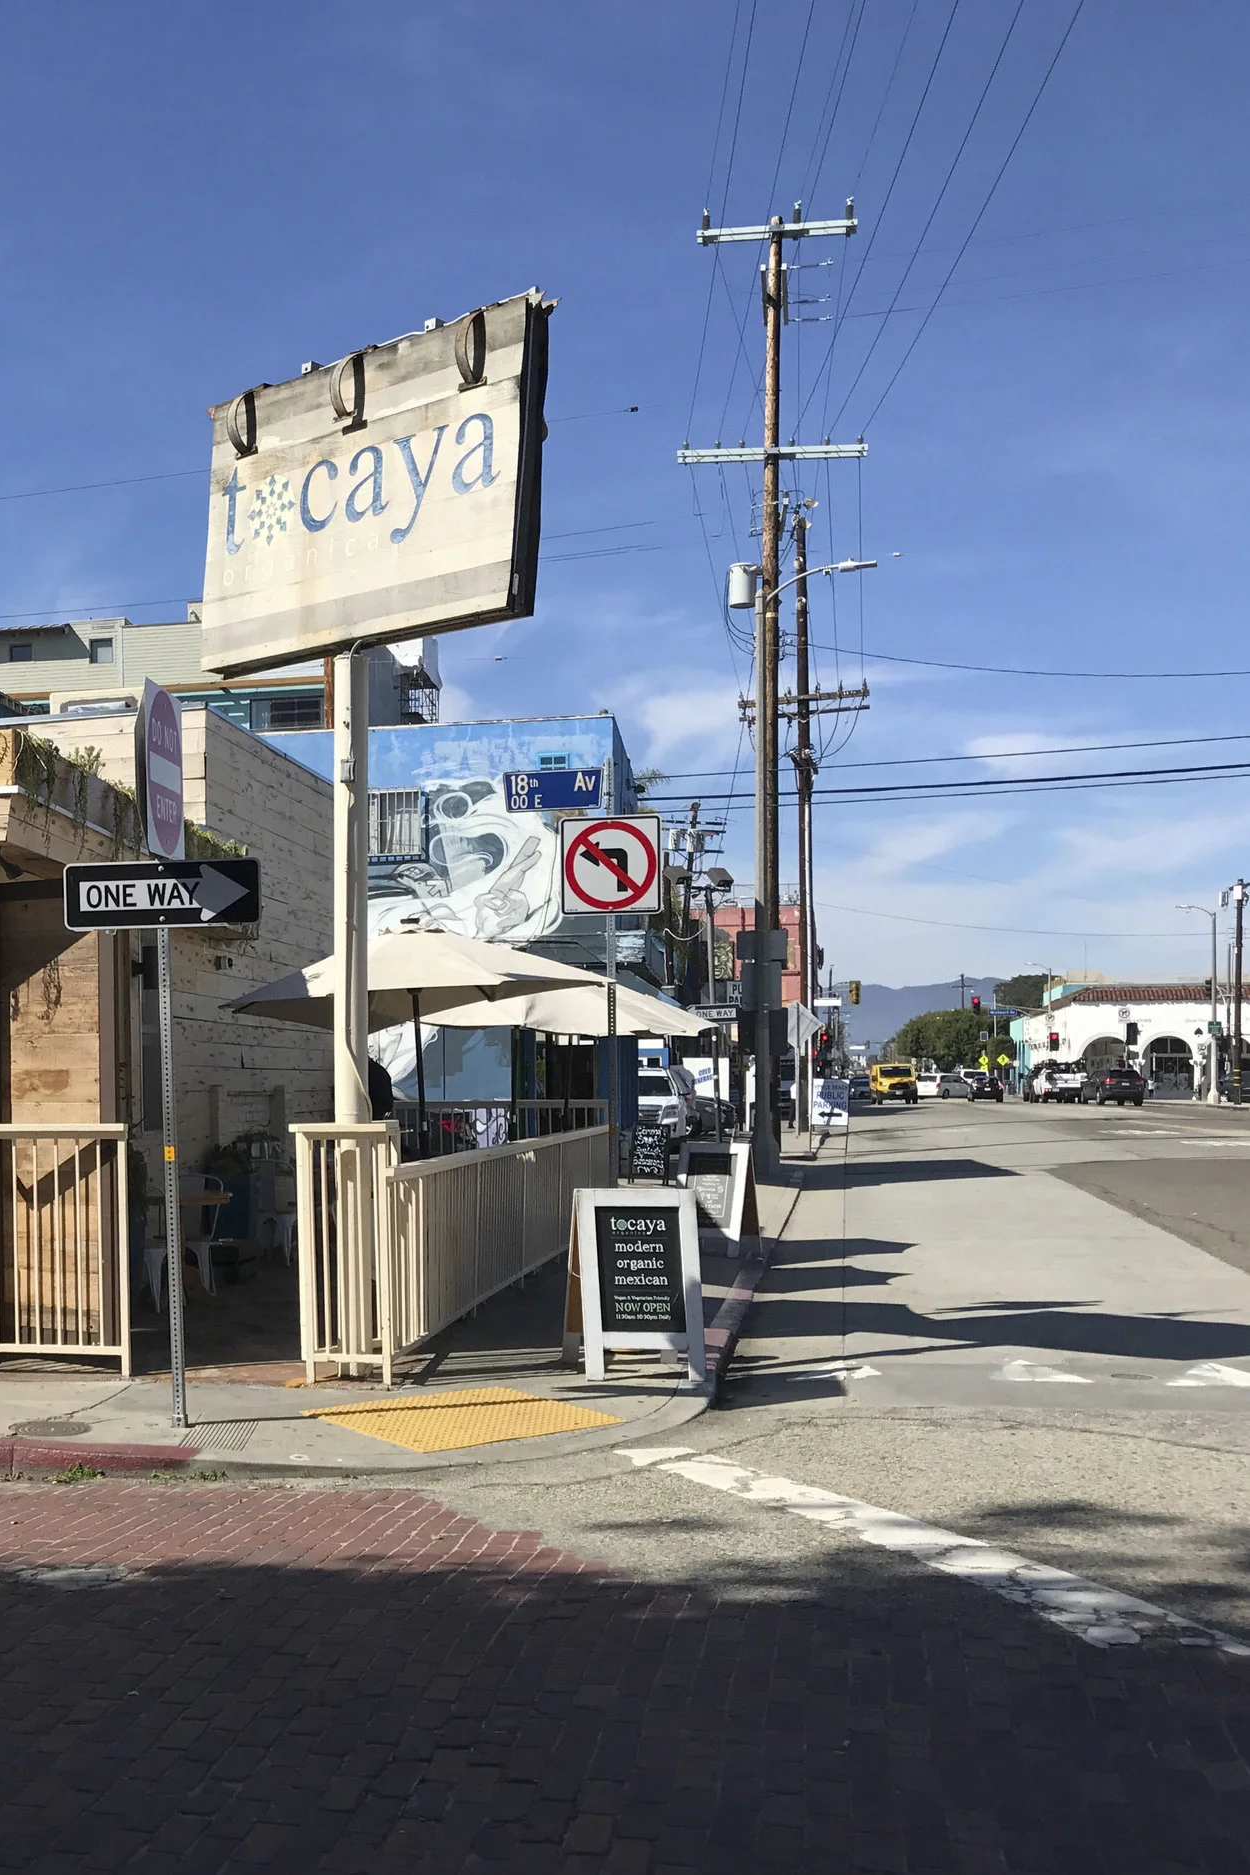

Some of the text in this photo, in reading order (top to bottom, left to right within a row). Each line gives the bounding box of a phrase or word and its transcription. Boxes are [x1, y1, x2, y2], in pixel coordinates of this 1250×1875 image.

[223, 532, 380, 587] organica
[151, 717, 178, 757] DO NOT
[510, 771, 596, 795] 18th Av
[511, 794, 543, 810] 00 E
[155, 794, 178, 827] ENTER
[86, 881, 201, 909] ONE WAY
[695, 1008, 735, 1019] ONE WAY
[816, 1091, 845, 1100] PUBLIC
[813, 1101, 847, 1110] PARKING
[610, 1216, 667, 1235] tocaya
[614, 1240, 665, 1252] modern
[616, 1257, 665, 1271] organic
[614, 1273, 669, 1285] mexican
[615, 1302, 671, 1312] NOW OPEN
